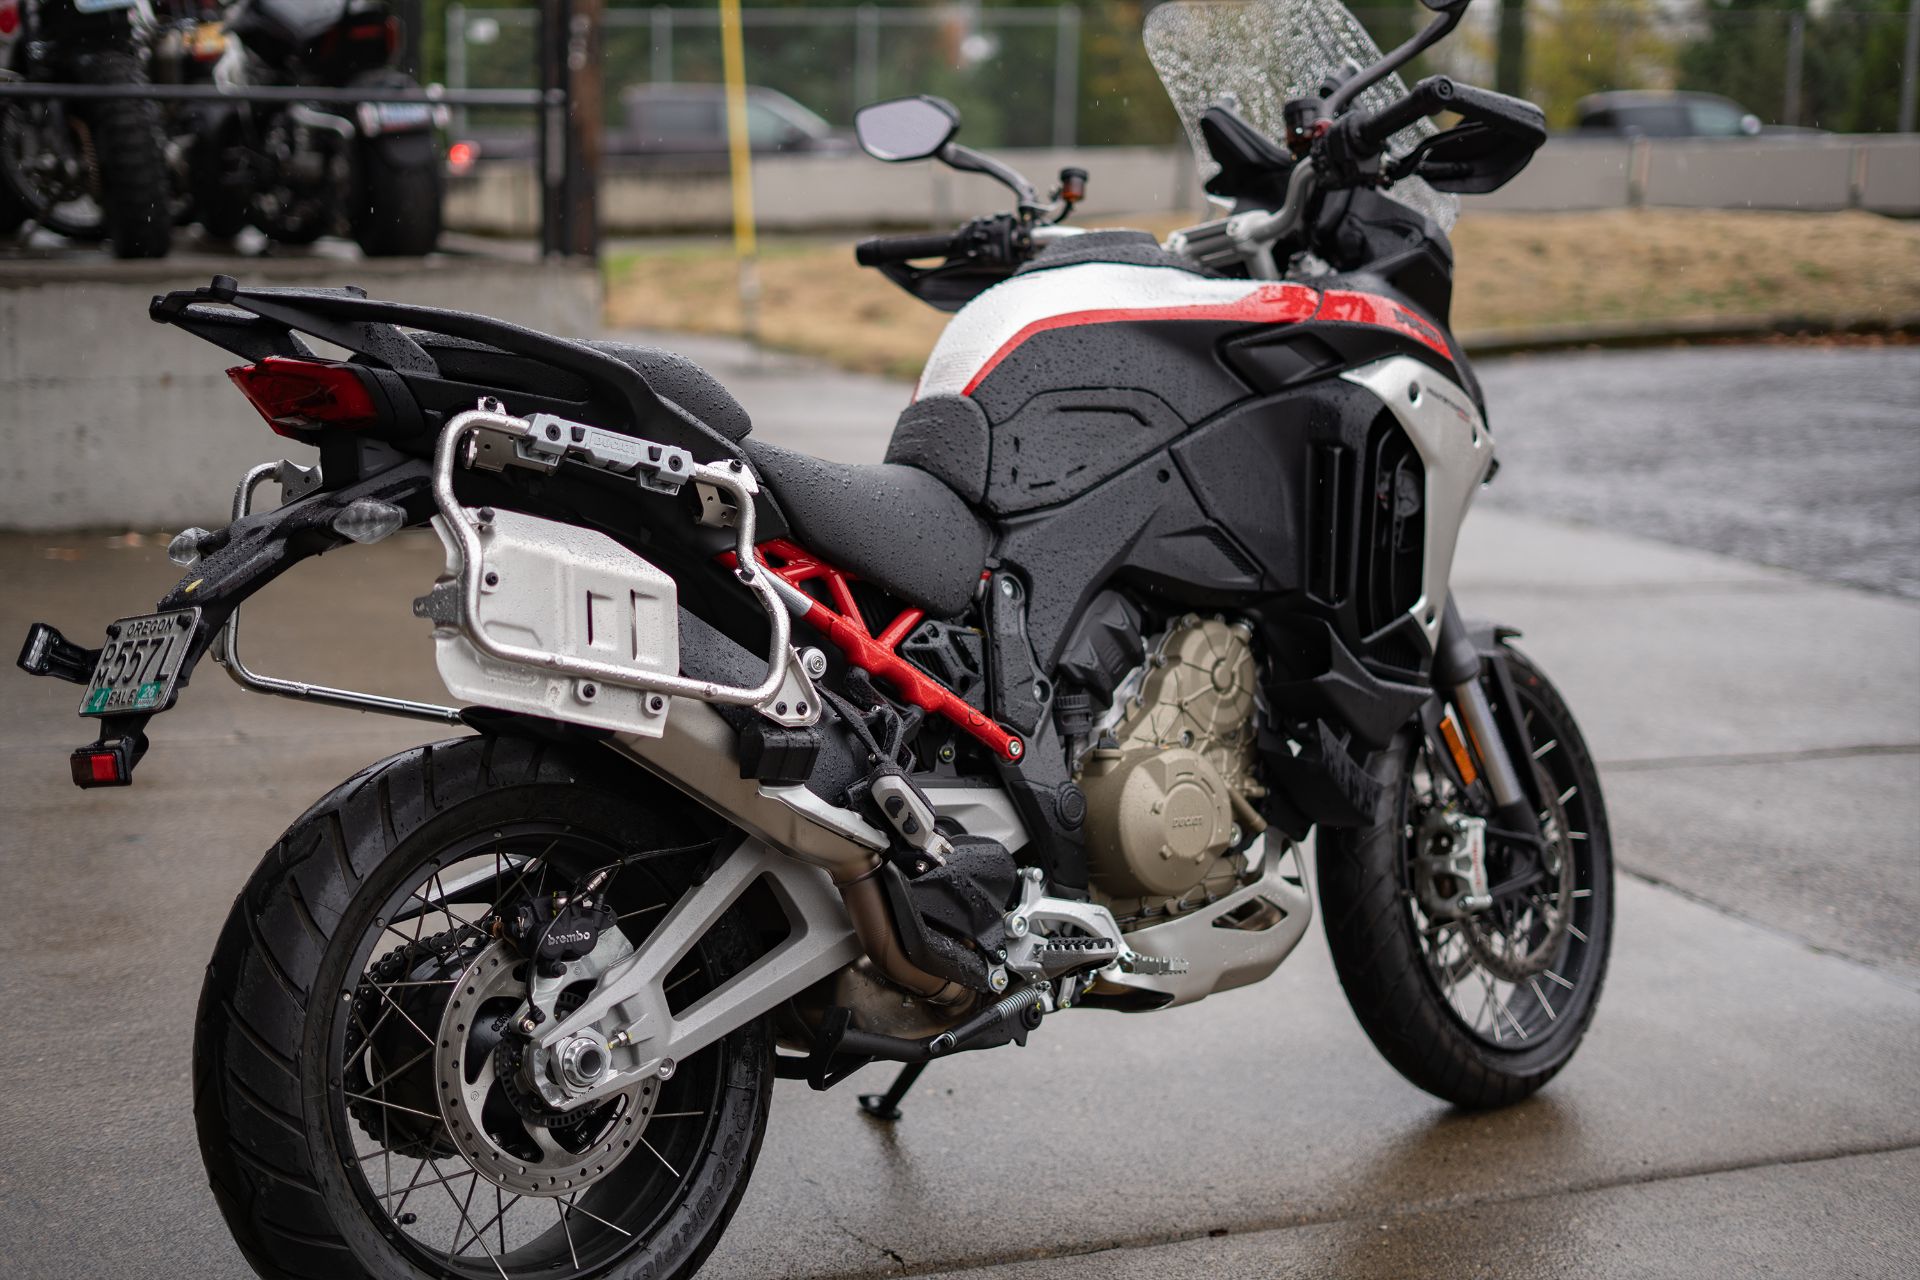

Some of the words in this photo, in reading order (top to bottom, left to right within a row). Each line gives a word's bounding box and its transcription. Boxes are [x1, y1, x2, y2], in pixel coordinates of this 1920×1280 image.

[127, 618, 175, 637] OREGON
[94, 693, 105, 710] 4
[106, 688, 138, 705] EALE
[547, 930, 591, 946] brembo
[624, 1133, 739, 1280] SCORPIO
